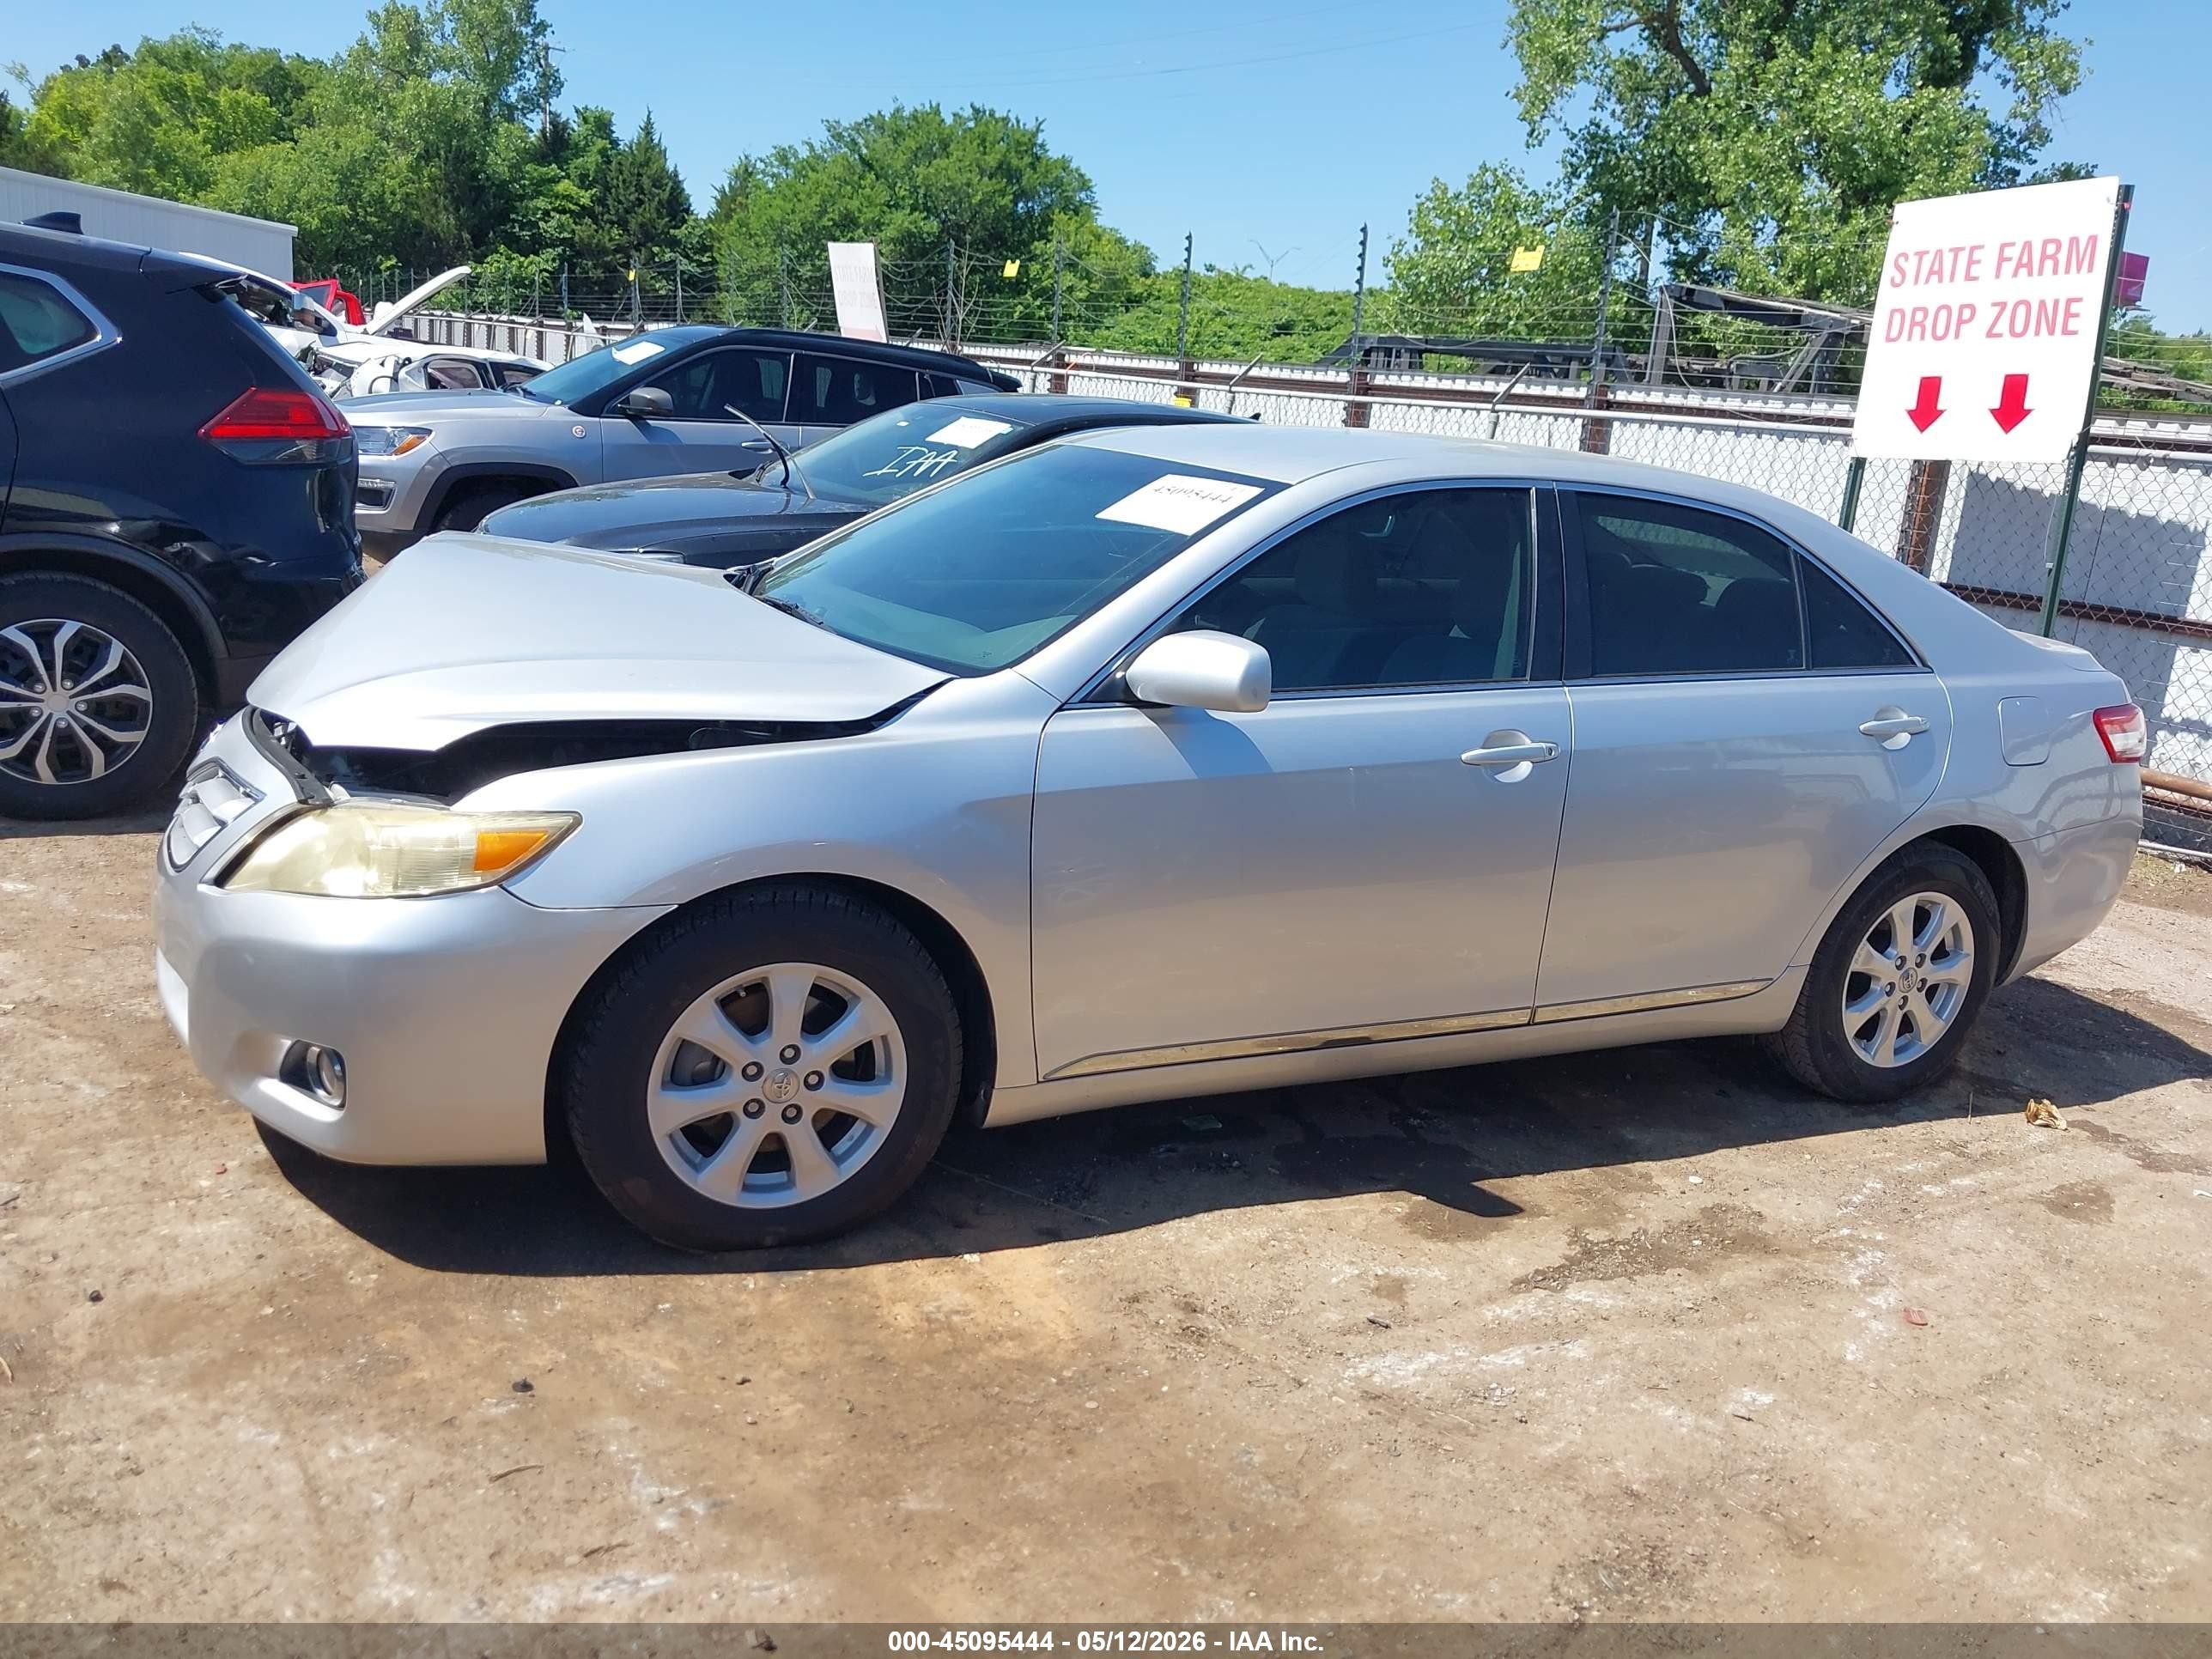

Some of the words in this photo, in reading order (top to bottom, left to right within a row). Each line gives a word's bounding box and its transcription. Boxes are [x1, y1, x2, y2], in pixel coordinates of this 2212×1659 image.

[1889, 244, 1985, 289] STATE
[1994, 234, 2099, 280] FARM
[1885, 303, 1977, 343] DROP
[1984, 296, 2084, 338] ZONE
[862, 446, 958, 478] IAA
